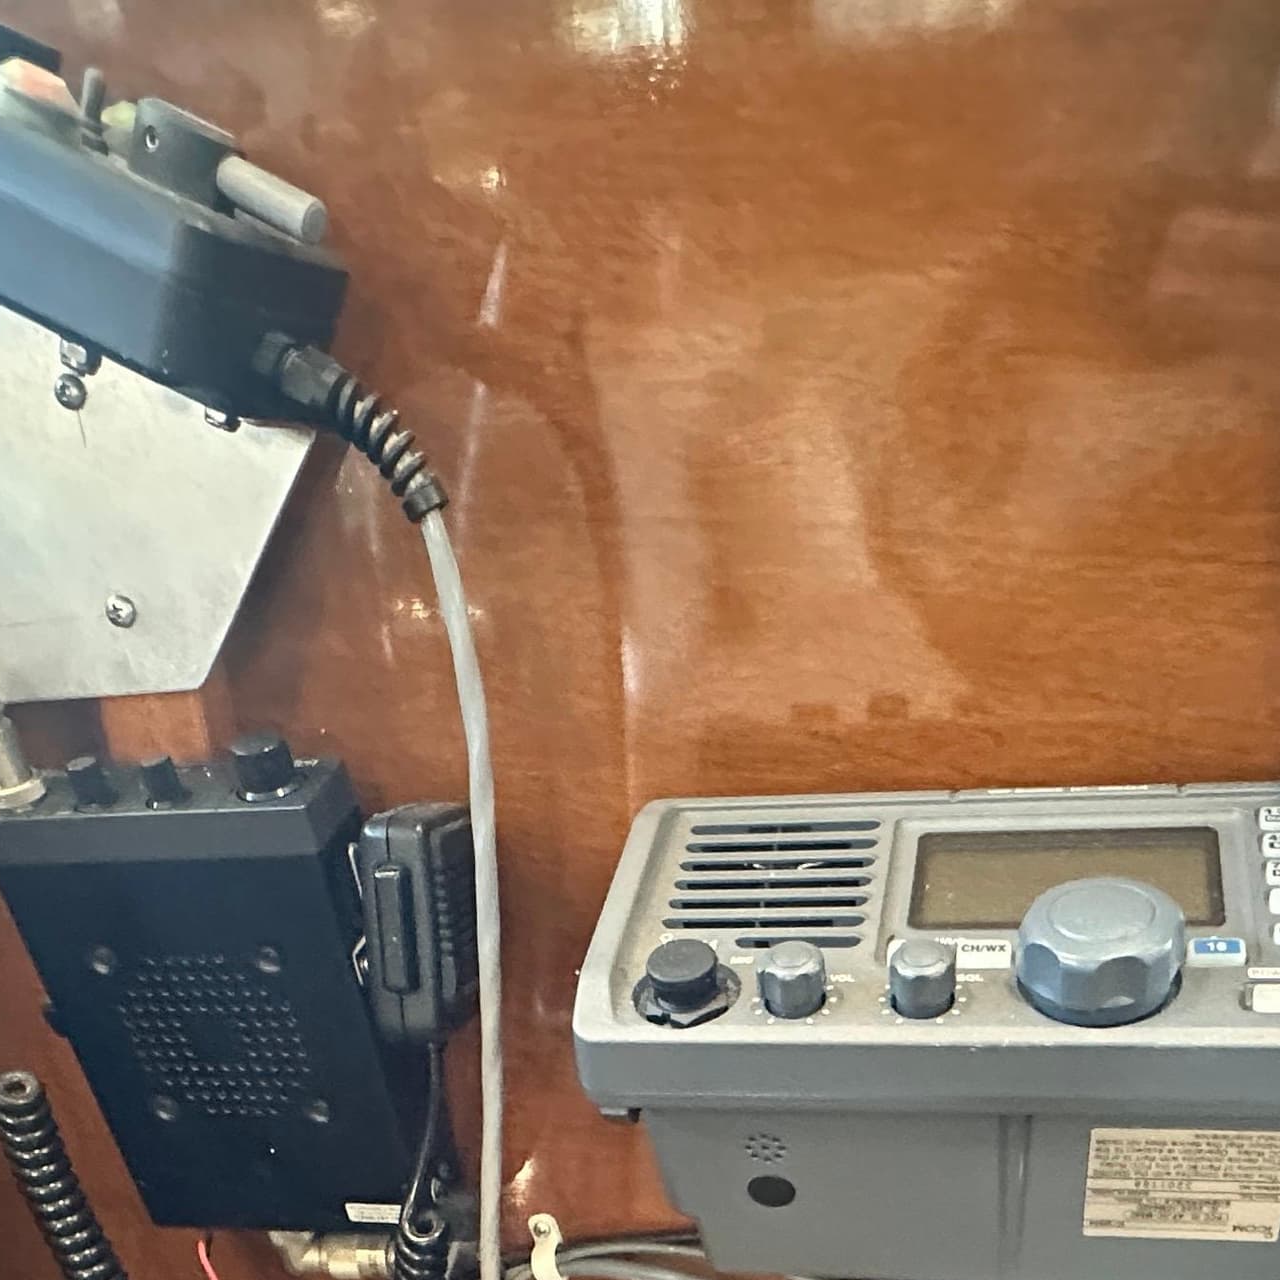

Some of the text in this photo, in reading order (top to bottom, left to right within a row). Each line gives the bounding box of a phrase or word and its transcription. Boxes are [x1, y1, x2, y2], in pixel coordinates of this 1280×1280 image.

[961, 944, 1007, 953] CH/WX
[1207, 941, 1227, 952] 16
[830, 974, 856, 983] VOL
